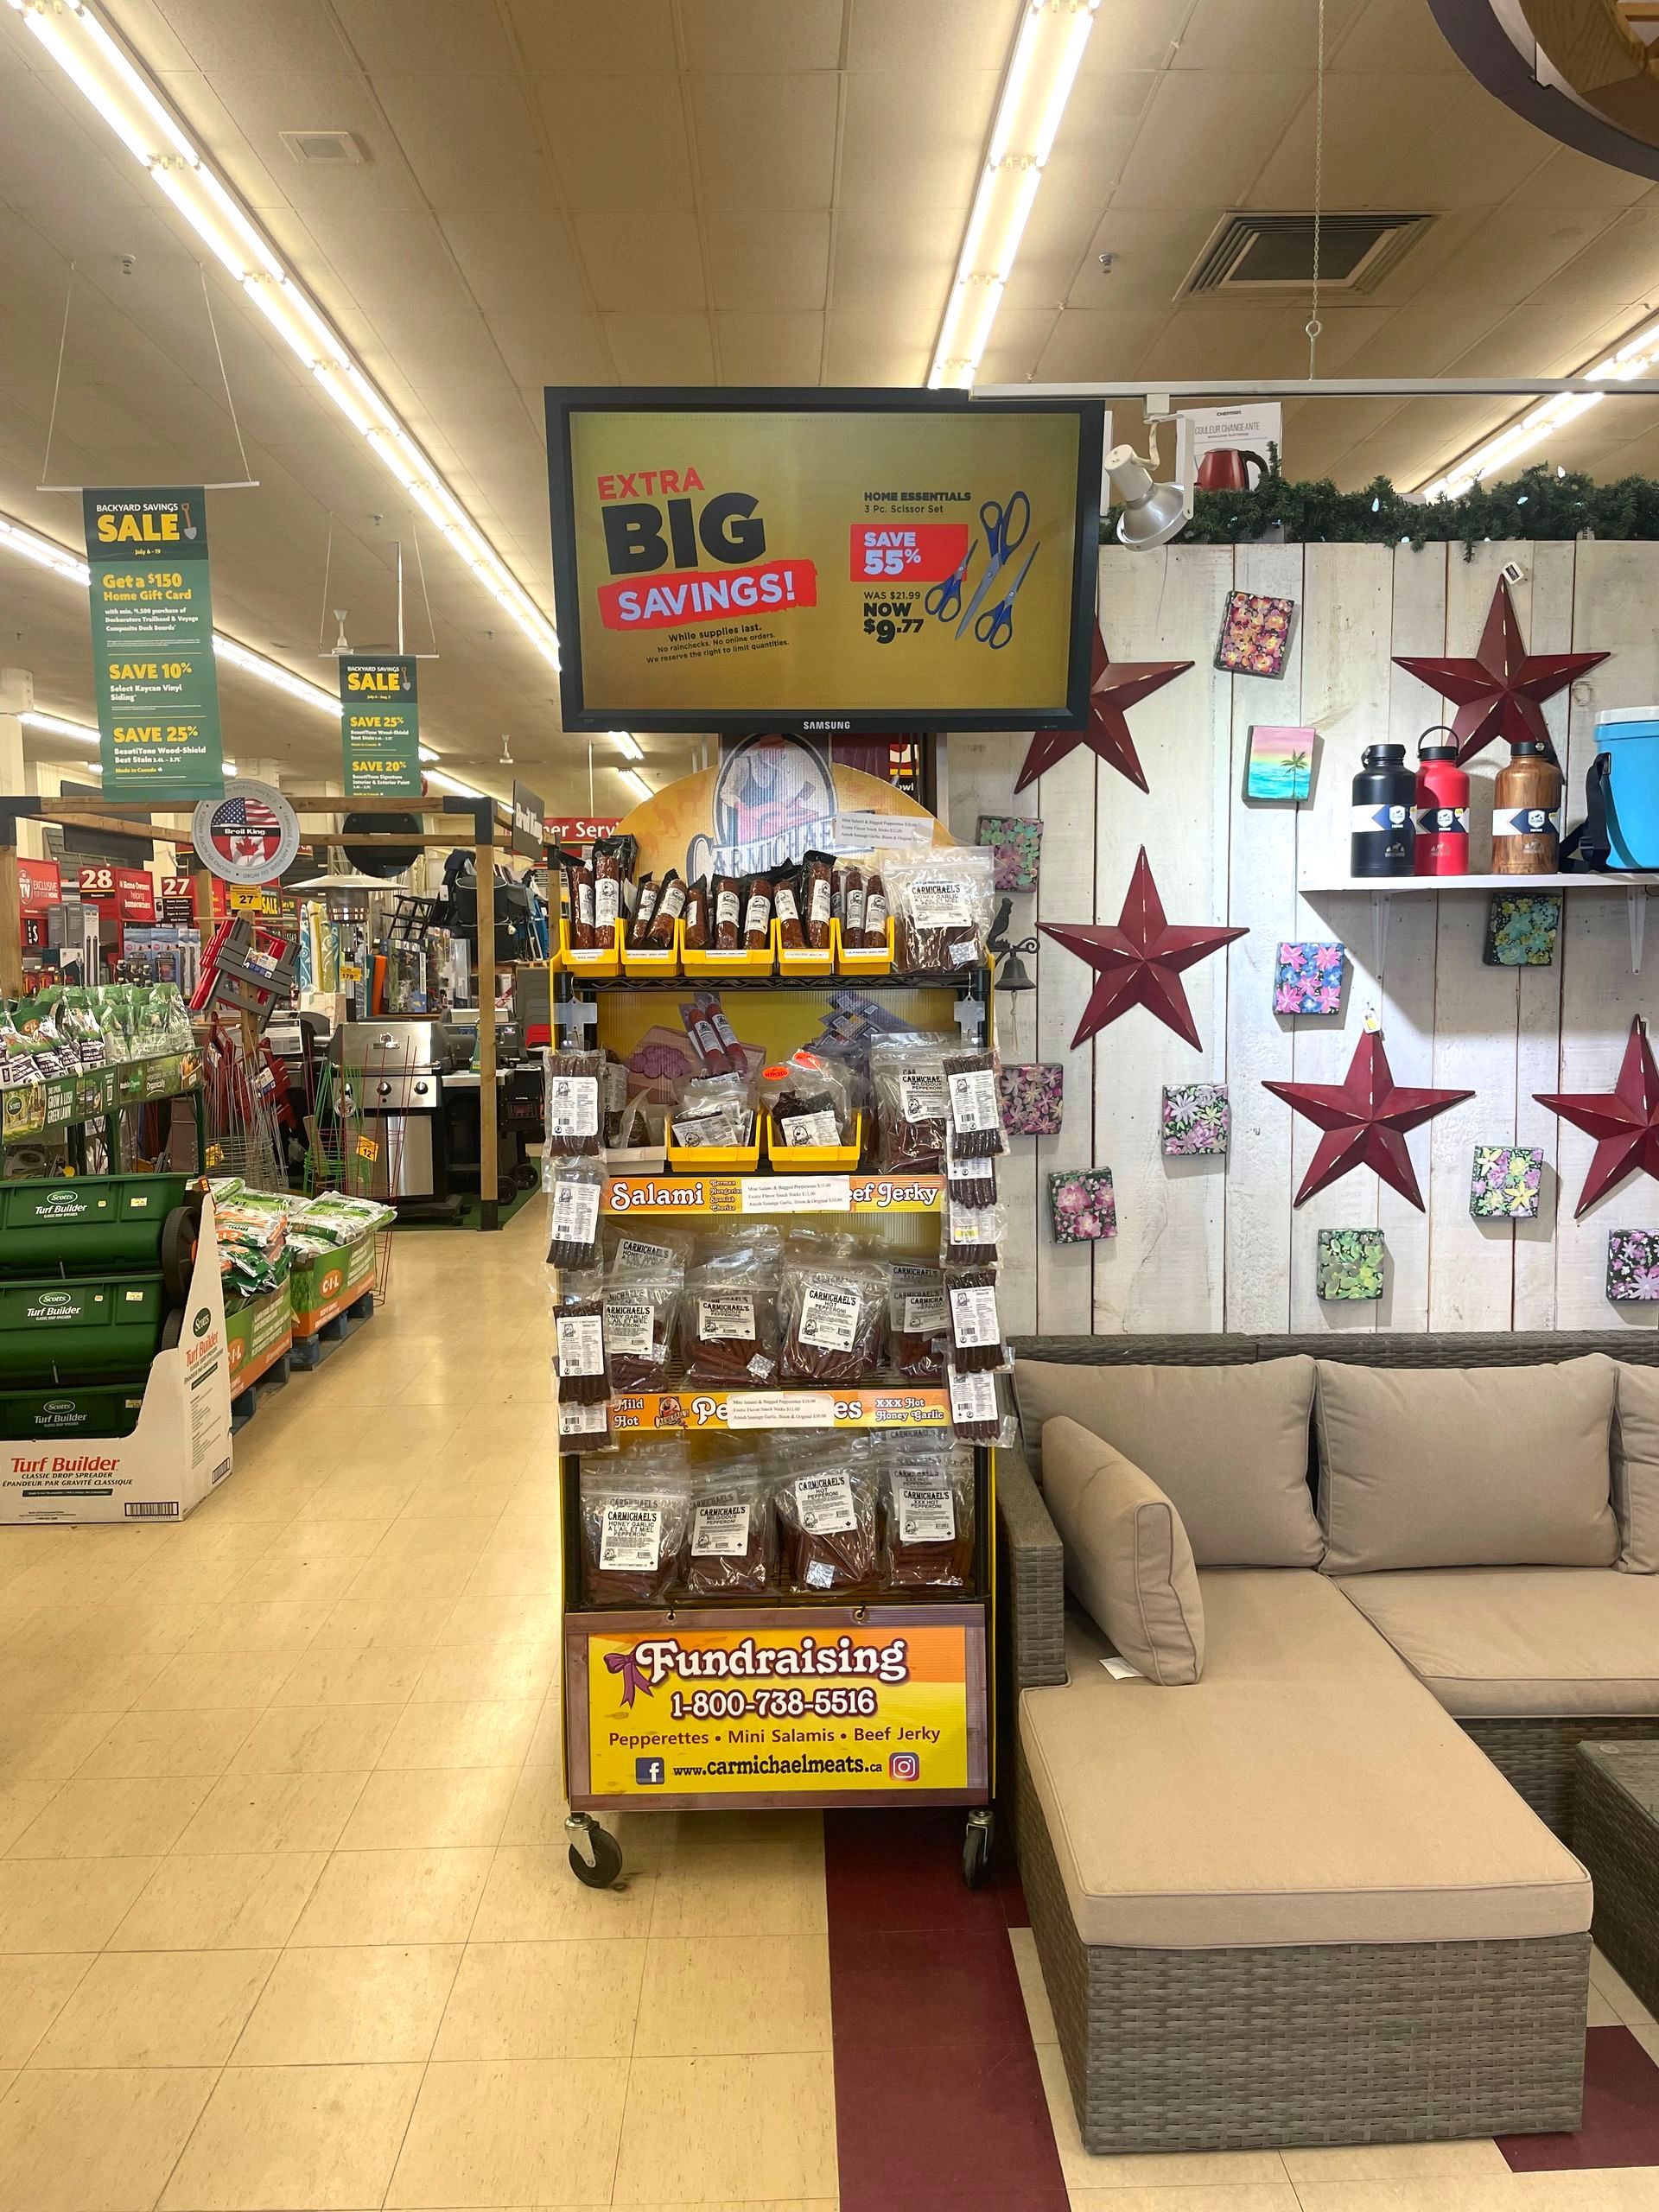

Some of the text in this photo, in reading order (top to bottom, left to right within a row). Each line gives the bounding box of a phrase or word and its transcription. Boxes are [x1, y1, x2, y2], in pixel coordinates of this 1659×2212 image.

[1195, 422, 1260, 435] COULEUR CHANGEANTE
[598, 467, 705, 500] EXTRA
[864, 492, 971, 501] HOME ESSENTIALS
[96, 503, 178, 513] BACKYARD SAVINGS
[872, 505, 887, 514] Pc.
[889, 505, 925, 513] Scissor
[928, 505, 944, 513] Set
[97, 514, 180, 542] SALE
[601, 492, 766, 575] BIG
[864, 531, 916, 547] SAVE
[864, 548, 921, 575] 55%
[103, 573, 182, 588] Get a $150
[103, 589, 192, 601] Home Gift Card
[619, 572, 795, 622] SAVINGS!
[864, 591, 920, 601] WAS $21.99
[864, 602, 912, 618] NOW
[668, 623, 762, 643] While supplies last.
[863, 618, 924, 645] $9.77
[658, 632, 775, 653] No rainchecks. No online orders.
[646, 655, 658, 664] We
[660, 652, 688, 662] reserve
[702, 646, 721, 658] right
[722, 645, 731, 654] to
[733, 643, 750, 653] limit
[751, 638, 790, 652] quantities.
[109, 662, 192, 680] SAVE 10%
[135, 684, 161, 693] Kaycan
[162, 683, 182, 693] Vinyl
[347, 673, 400, 691] SALE
[350, 716, 404, 728] SAVE 25%
[803, 721, 851, 730] SAMSUNG
[113, 726, 198, 743] SAVE 25%
[353, 761, 406, 772] SAVE 20%
[575, 821, 620, 842] Serv
[81, 869, 113, 889] 28
[20, 884, 31, 899] TV
[163, 878, 190, 896] 27
[912, 885, 960, 895] CARMICHAEL'S
[239, 895, 254, 904] 27
[262, 897, 277, 914] SALE
[610, 1182, 704, 1211] Salami
[877, 1182, 938, 1207] Jerky
[35, 1202, 88, 1215] Turf Builder
[623, 1241, 669, 1259] CARMICHAEL'S
[893, 1267, 938, 1277] CARMICHAEL'S
[43, 1295, 67, 1304] Scotts
[809, 1290, 856, 1306] CARMICHAEL'S
[27, 1306, 81, 1318] Turf Builder
[702, 1302, 750, 1312] CARMICHAEL'S
[815, 1303, 847, 1313] PEPPERONI
[195, 1314, 210, 1332] Scotts
[186, 1344, 199, 1367] Turf
[200, 1332, 219, 1357] Builder
[613, 1398, 644, 1413] Mild
[875, 1398, 925, 1408] XXX Hot
[34, 1412, 87, 1424] Turf Builder
[613, 1415, 639, 1429] Hot
[875, 1409, 944, 1421] Honey Garlic
[11, 1456, 120, 1472] Turf Builder
[798, 1477, 845, 1491] CARMICHAEL'S
[807, 1491, 839, 1499] PEPPERONI
[904, 1491, 950, 1500] CARMICHAEL'S
[607, 1511, 657, 1522] CARMICHAEL'S
[699, 1506, 746, 1516] CARMICHAEL'S
[636, 1637, 907, 1682] Fundraising
[671, 1689, 876, 1718] 1-800-738-5516
[608, 1727, 941, 1749] Pepperettes Mini Salamis Beef Jerky
[673, 1755, 882, 1777] www.carmichaelmeats.ca
